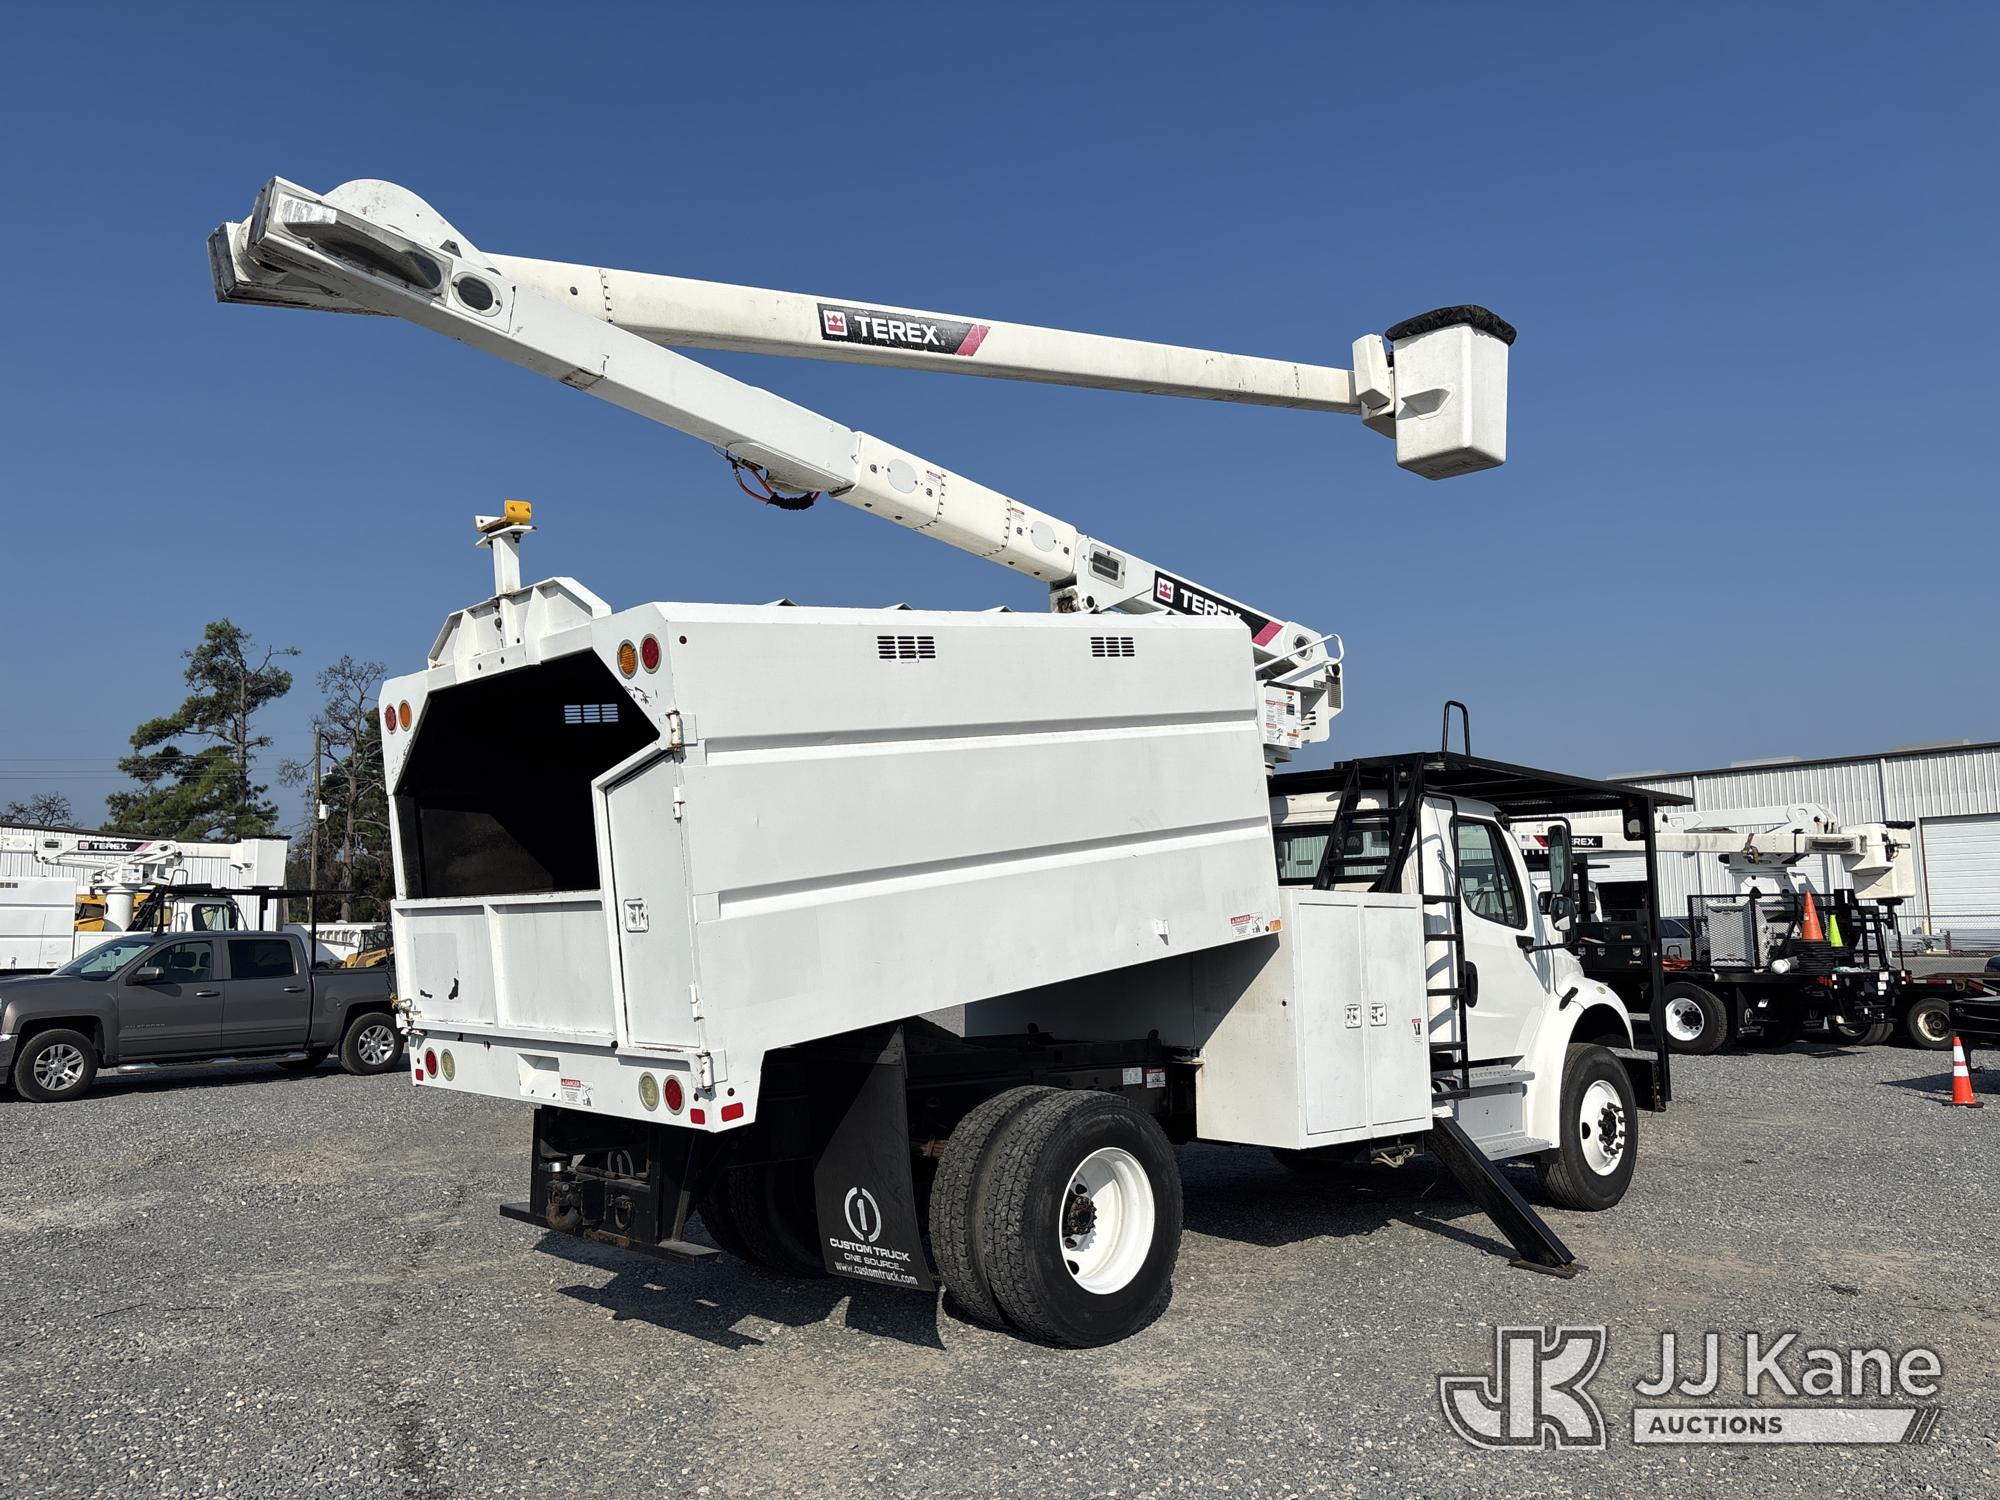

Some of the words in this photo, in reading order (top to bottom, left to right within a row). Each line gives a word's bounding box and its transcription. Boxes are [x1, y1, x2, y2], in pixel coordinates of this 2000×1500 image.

[853, 316, 940, 345] TEREX
[92, 842, 128, 850] TEREX
[1571, 838, 1595, 846] REX
[829, 1237, 873, 1254] CUSTOM
[873, 1246, 911, 1262] TRUCK
[843, 1252, 862, 1263] ONE
[863, 1257, 901, 1270] SOURCE
[834, 1260, 918, 1286] www.customtruck.com
